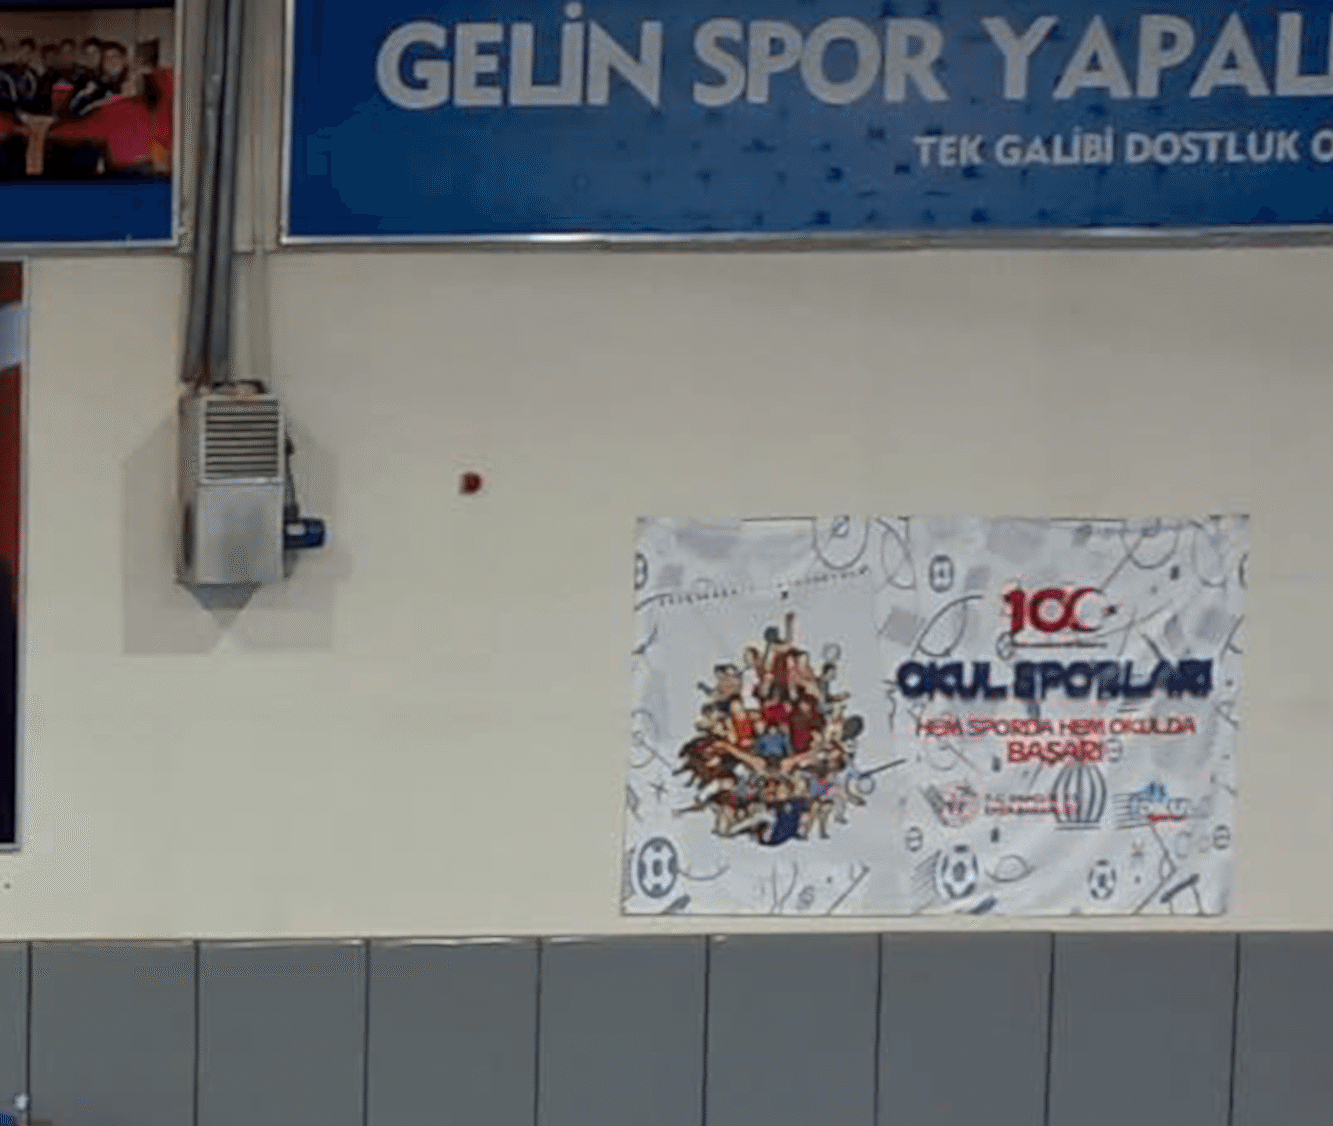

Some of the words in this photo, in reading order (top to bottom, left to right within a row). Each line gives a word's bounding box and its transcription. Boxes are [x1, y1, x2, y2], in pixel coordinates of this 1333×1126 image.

[374, 1, 665, 110] GELİN
[691, 16, 950, 109] SPOR
[979, 11, 1333, 99] YAPAL
[913, 133, 985, 168] TEK
[993, 125, 1115, 167] GALİBİ
[1125, 128, 1302, 164] DOSTLUK
[896, 660, 1009, 700] OKUL
[916, 717, 964, 737] HEM
[967, 717, 1054, 737] SPORDA
[1058, 717, 1105, 736] HEM
[1109, 716, 1198, 735] OKULDA
[1007, 740, 1105, 766] BAŞARI
